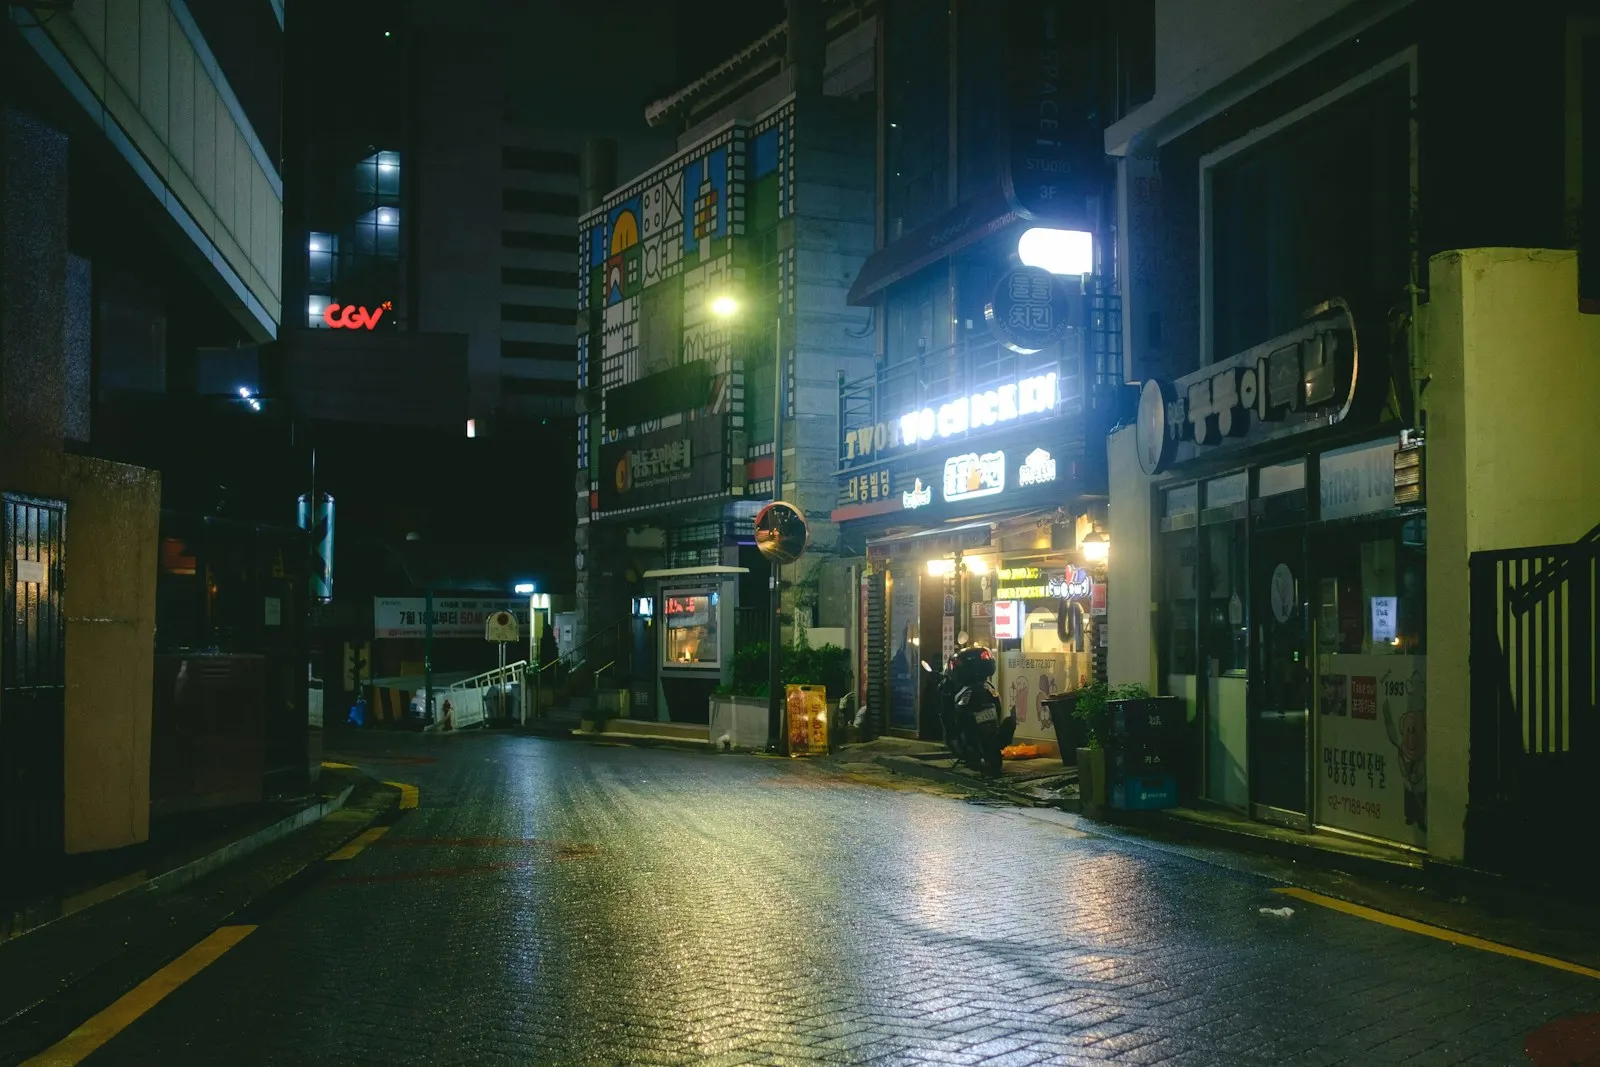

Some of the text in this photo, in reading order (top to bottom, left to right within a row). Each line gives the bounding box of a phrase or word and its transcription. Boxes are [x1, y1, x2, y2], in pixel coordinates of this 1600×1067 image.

[1026, 157, 1070, 173] STUDIO
[1039, 184, 1057, 199] 3F
[323, 303, 384, 331] CGV
[1011, 306, 1050, 328] 치킨
[848, 468, 890, 501] 대동빌딩
[400, 611, 415, 625] 7월
[1385, 681, 1405, 697] 1993
[1144, 755, 1162, 764] 카스
